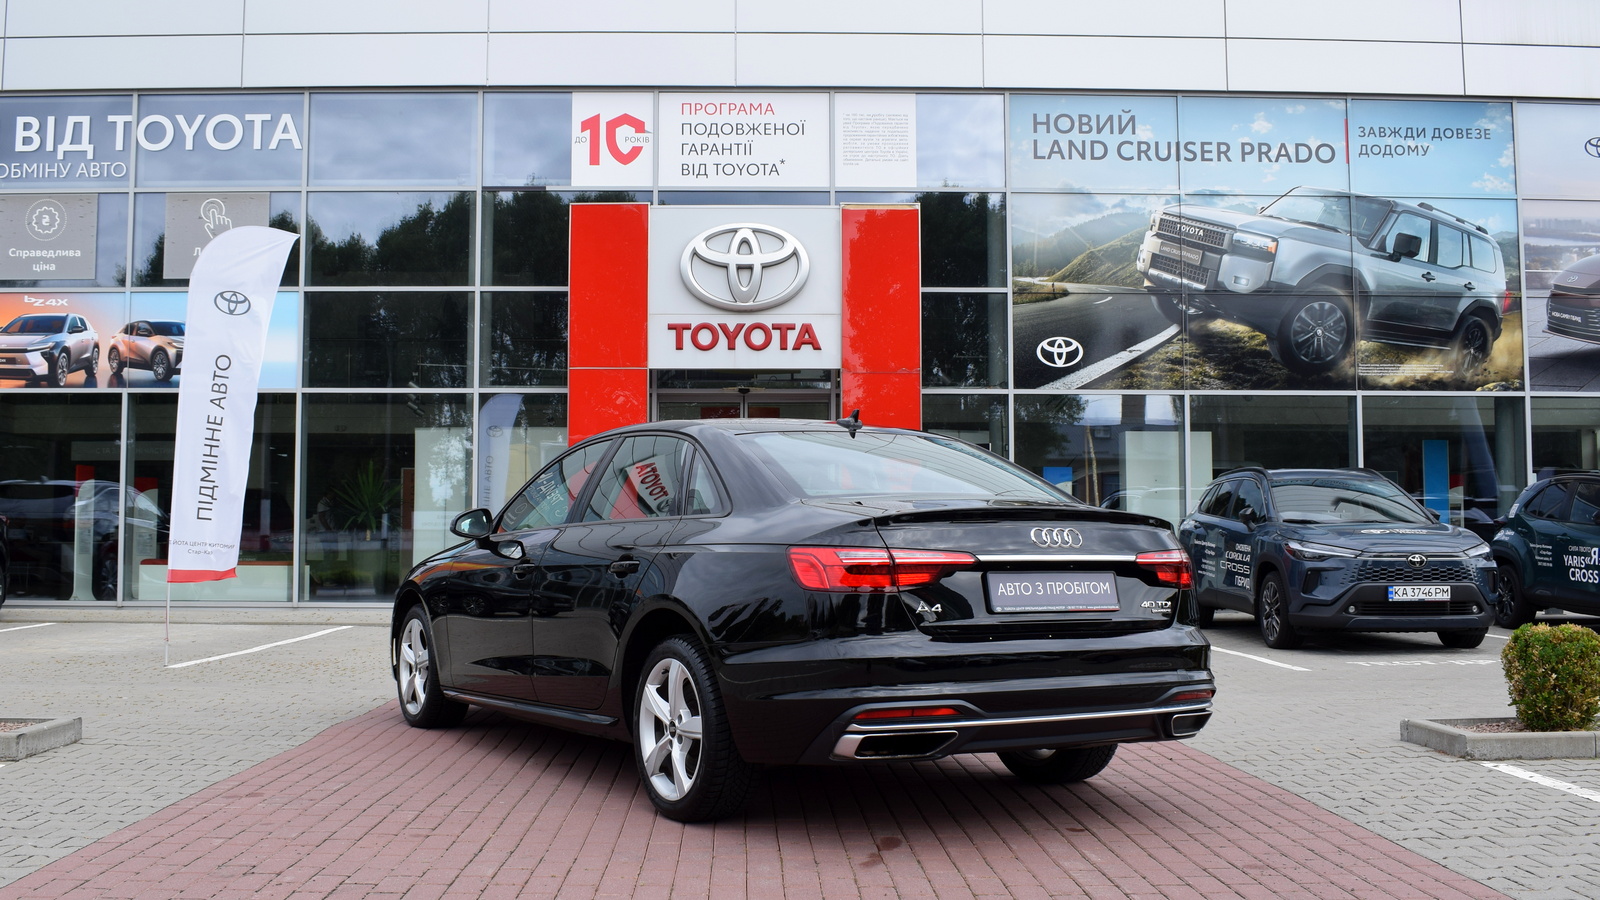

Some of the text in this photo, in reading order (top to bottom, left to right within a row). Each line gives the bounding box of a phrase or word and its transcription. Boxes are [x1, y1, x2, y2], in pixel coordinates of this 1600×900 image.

[681, 102, 775, 116] ПРОГРАМА
[681, 119, 807, 139] ПОДОВЖЕНОЇ
[1032, 109, 1137, 135] НОВИЙ
[14, 113, 303, 160] ВІД TOYOTA
[574, 136, 650, 144] ДО РОКІВ
[1357, 126, 1492, 142] ЗАВЖДИ ДОВЕЗЕ
[681, 139, 754, 156] ГАРАНТІЇ
[1032, 139, 1336, 164] LAND CRUISER PRADO
[1358, 144, 1430, 158] ДОДОМУ
[76, 161, 127, 178] АВТО
[681, 163, 709, 179] ВІД
[1176, 223, 1204, 237] TOYOTA
[9, 247, 82, 260] Справедлива
[32, 262, 56, 273] ціна
[667, 322, 822, 351] TOYOTA
[197, 354, 232, 521] ПІДМІННЕ АВТО
[1225, 550, 1251, 562] COROLLA
[1563, 554, 1586, 568] YARIS
[1220, 560, 1251, 575] CROSS
[1569, 568, 1599, 584] CROSS
[997, 582, 1032, 596] АВТО
[1046, 581, 1111, 595] ПРОБІГОМ
[1394, 587, 1449, 598] KA 3746 PM
[915, 600, 943, 614] A4
[1141, 600, 1155, 608] 40
